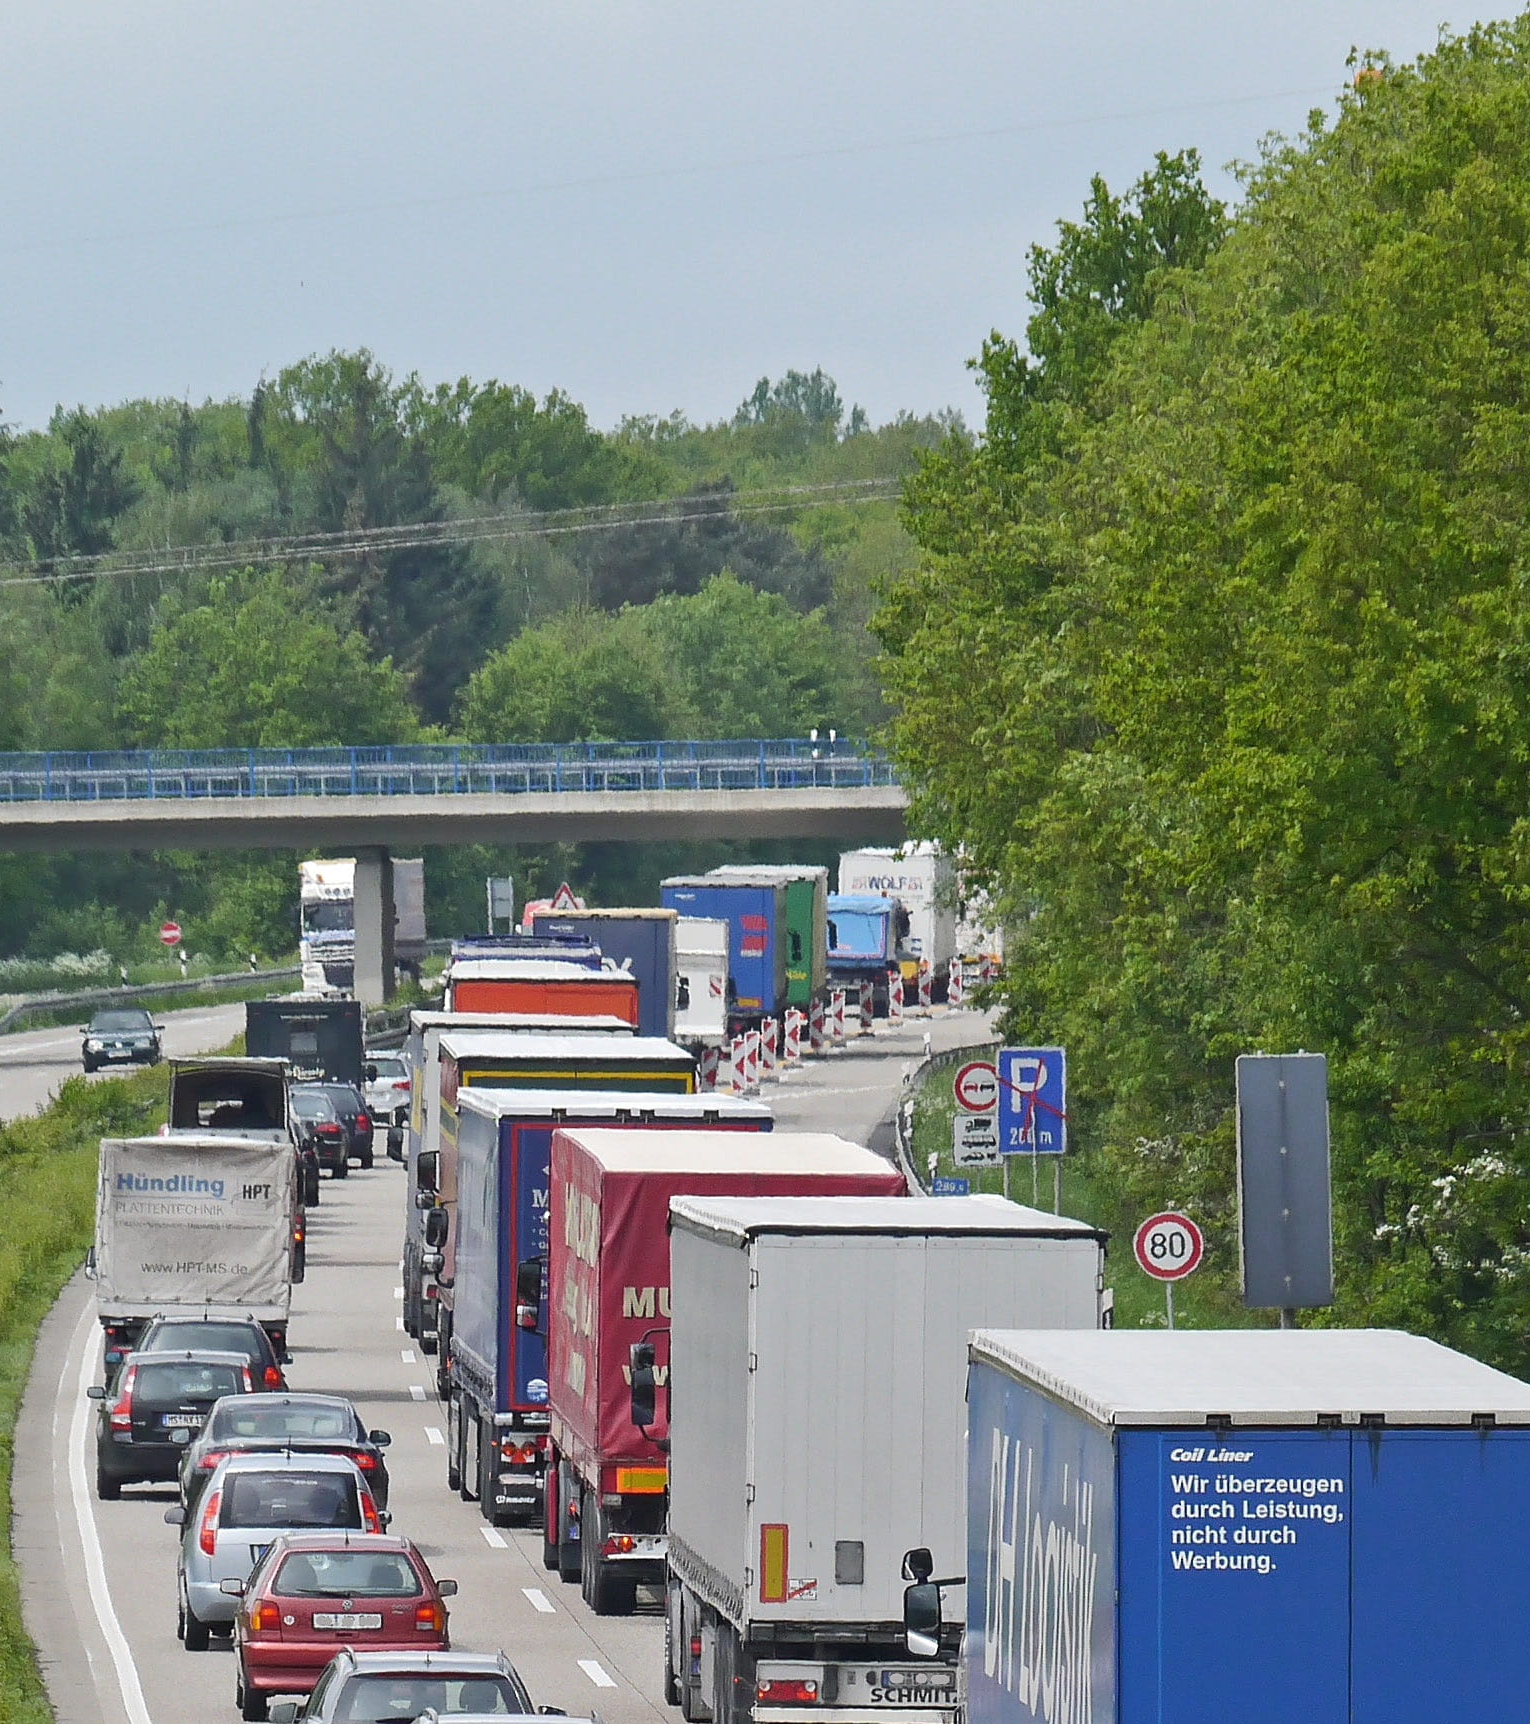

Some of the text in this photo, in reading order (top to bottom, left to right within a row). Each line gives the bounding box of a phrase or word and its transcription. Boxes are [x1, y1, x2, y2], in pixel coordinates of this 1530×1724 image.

[1010, 1058, 1047, 1113] P
[117, 1173, 225, 1199] Hündling
[242, 1184, 271, 1200] HPT
[1151, 1232, 1185, 1259] 80
[1170, 1448, 1254, 1462] Coil Liner
[1171, 1475, 1344, 1498] Wir überzeugen
[1171, 1500, 1344, 1524] durch Leistung,
[1172, 1525, 1297, 1544] nicht durch
[1171, 1551, 1277, 1574] Werbung.
